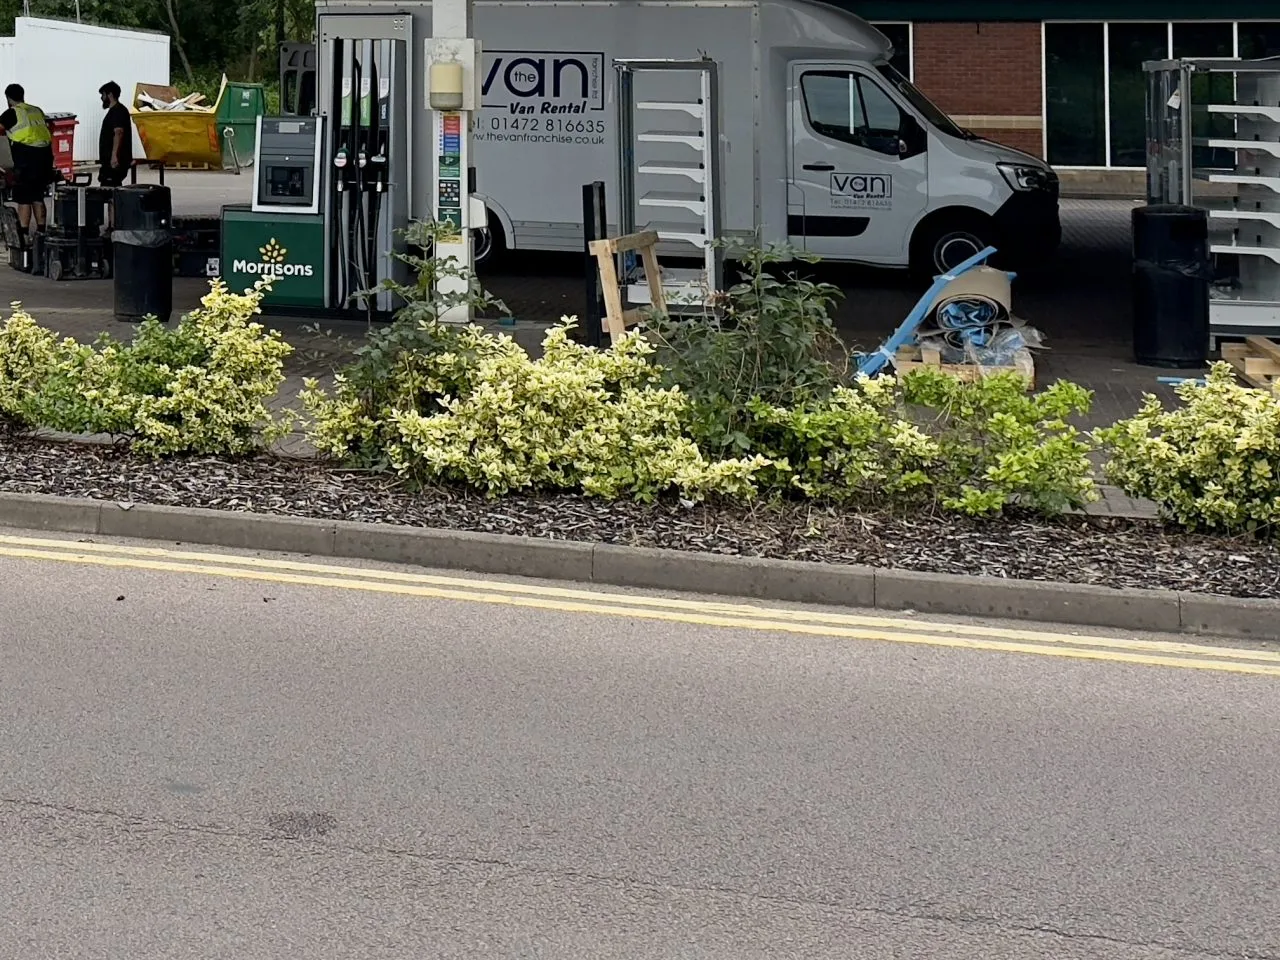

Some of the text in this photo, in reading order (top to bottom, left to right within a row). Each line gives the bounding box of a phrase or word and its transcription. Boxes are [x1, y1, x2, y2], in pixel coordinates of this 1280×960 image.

[514, 70, 536, 82] the
[510, 100, 587, 115] Van Rental
[491, 117, 539, 131] 01472
[545, 119, 605, 134] 816635
[833, 176, 885, 192] van
[233, 259, 313, 276] Morrisons
